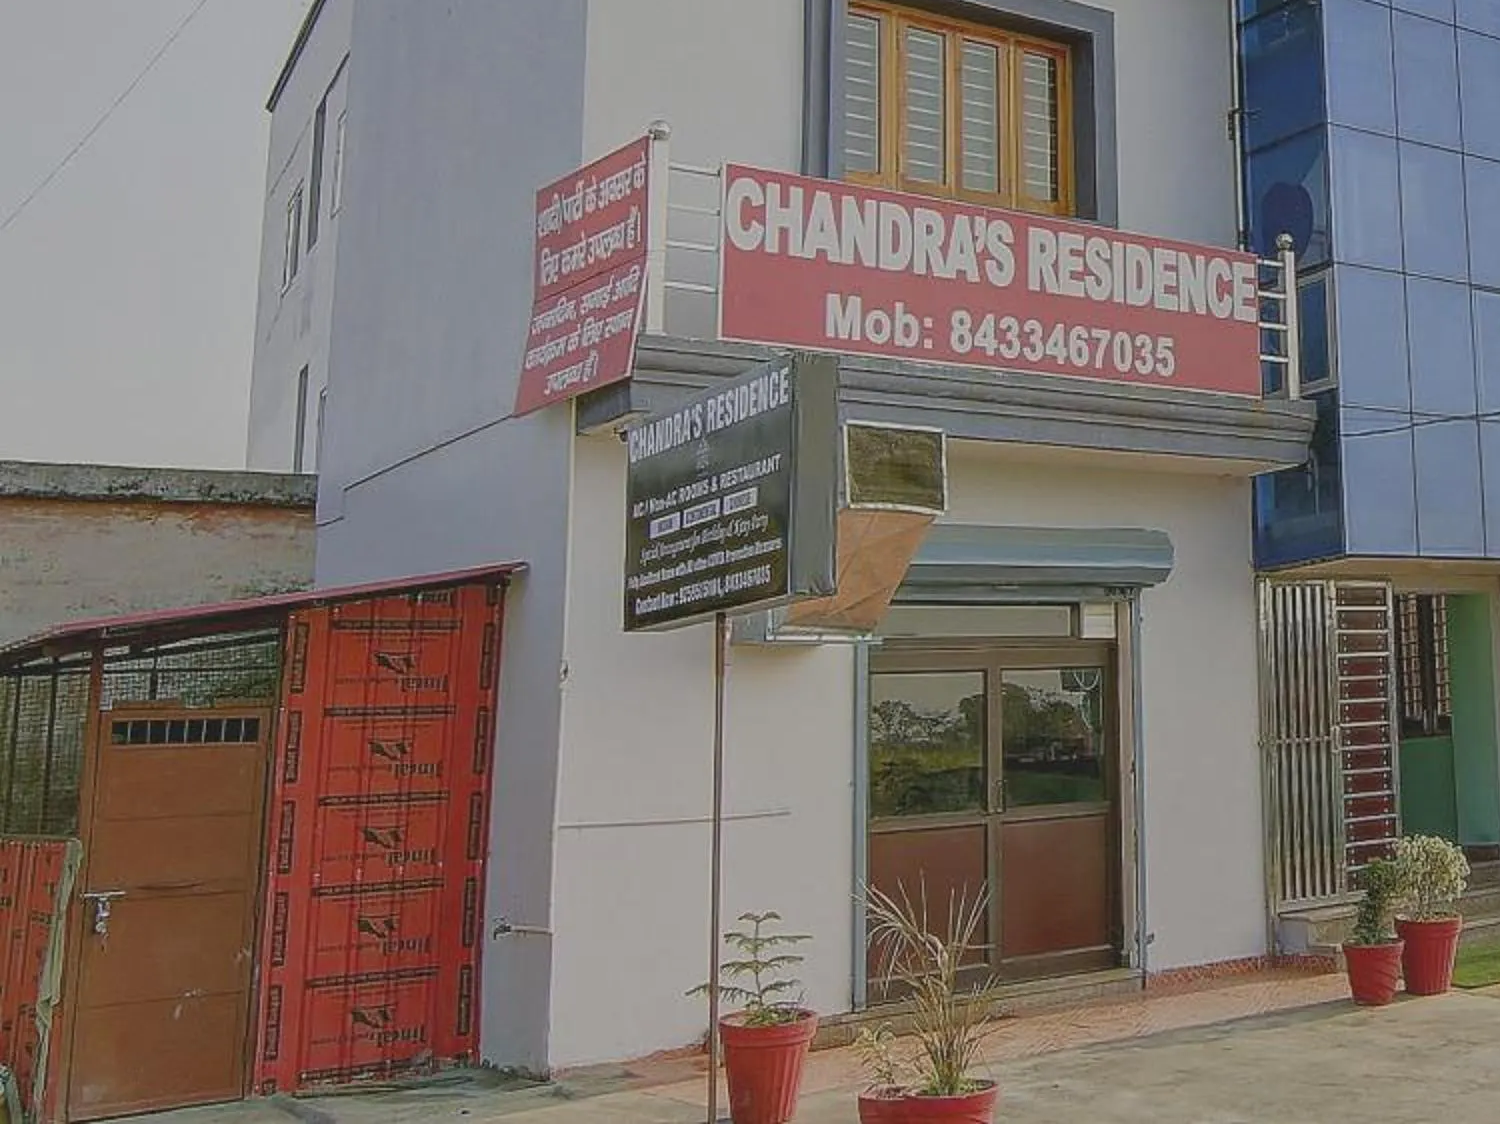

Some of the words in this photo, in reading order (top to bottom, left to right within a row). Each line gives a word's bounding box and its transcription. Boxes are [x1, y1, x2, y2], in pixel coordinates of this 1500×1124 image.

[726, 176, 1014, 289] CHANDRA'S
[1028, 225, 1257, 321] RESIDENCE
[825, 293, 935, 348] Mob:
[950, 309, 1176, 378] 8433467035
[629, 402, 704, 463] CHANDRA'S
[706, 366, 789, 431] RESIDENCE
